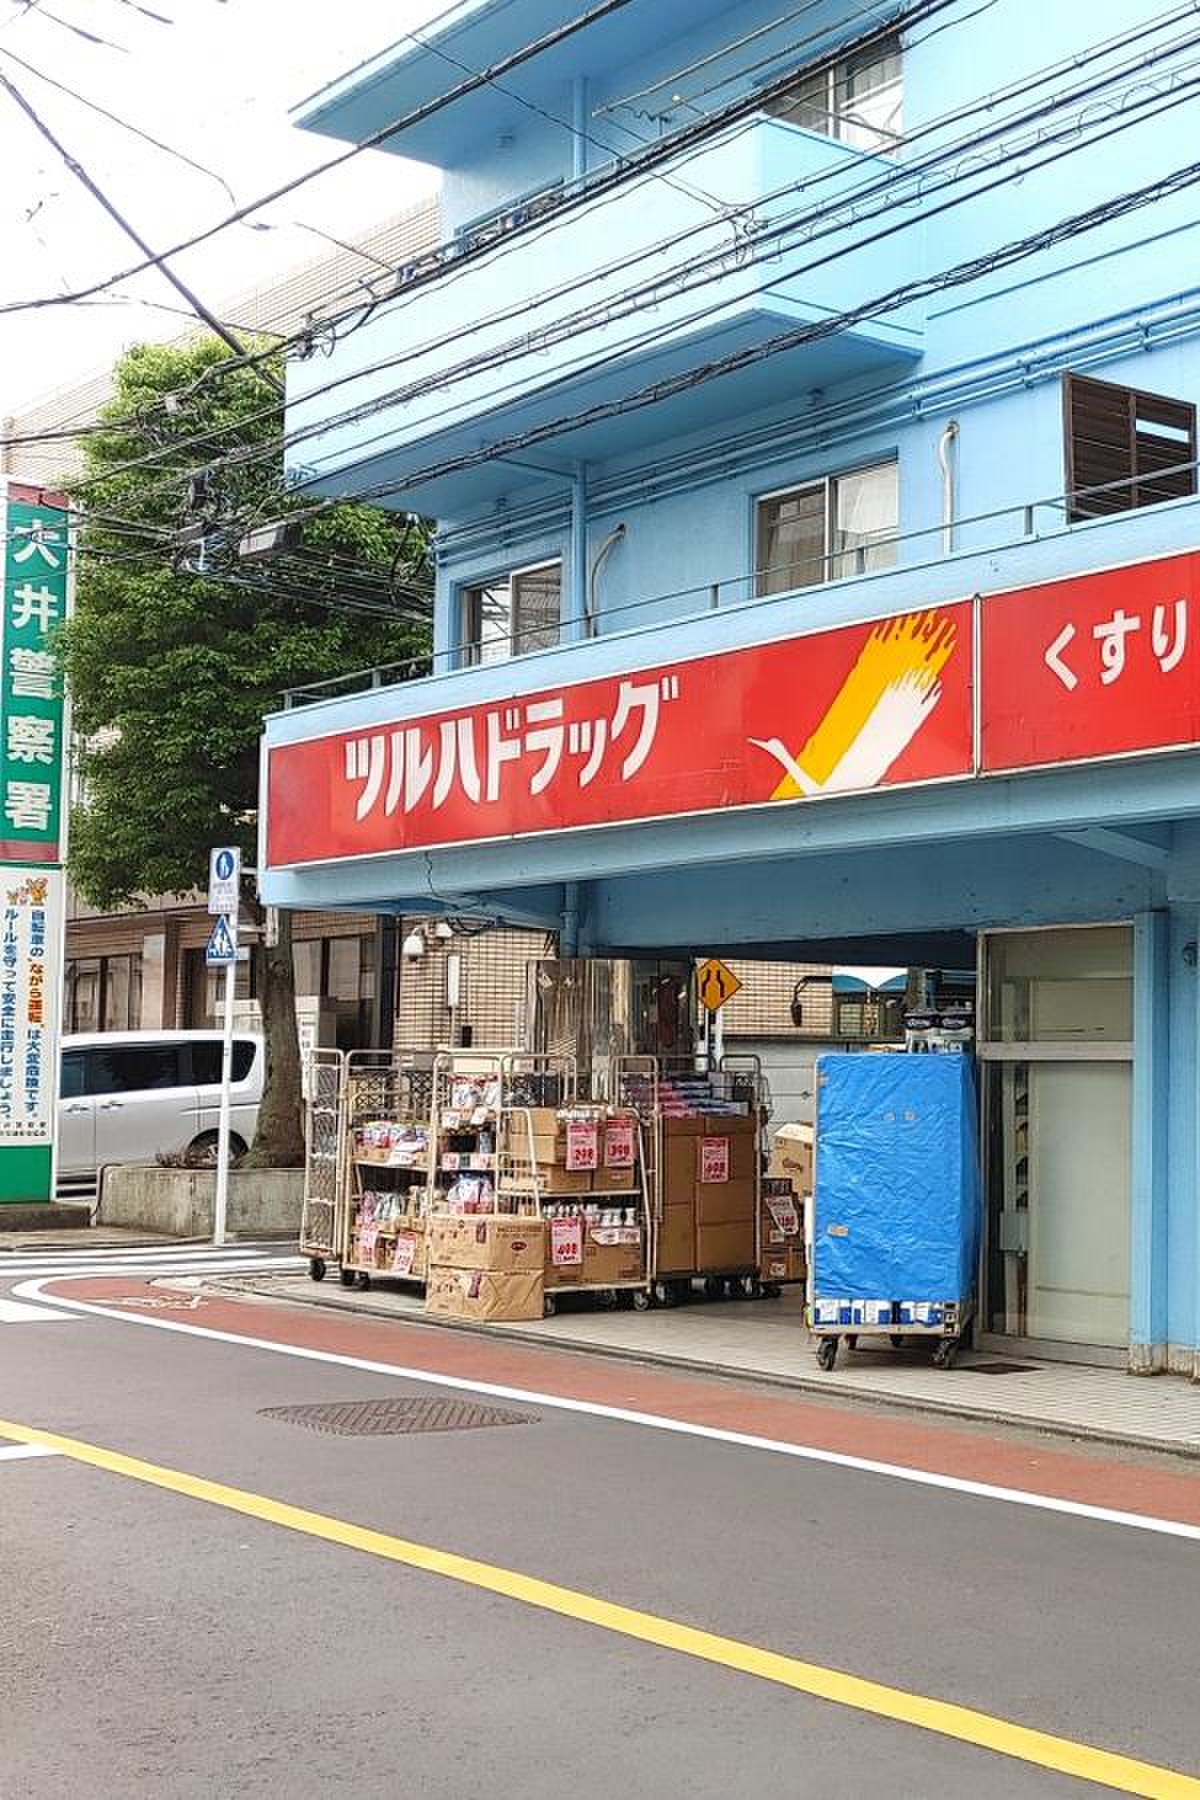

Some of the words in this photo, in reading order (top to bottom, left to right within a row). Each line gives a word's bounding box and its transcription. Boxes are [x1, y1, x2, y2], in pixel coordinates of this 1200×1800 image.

[4, 519, 59, 831] 大井警察署
[1043, 602, 1189, 691] くすり
[345, 675, 680, 821] ツルハドラッグ
